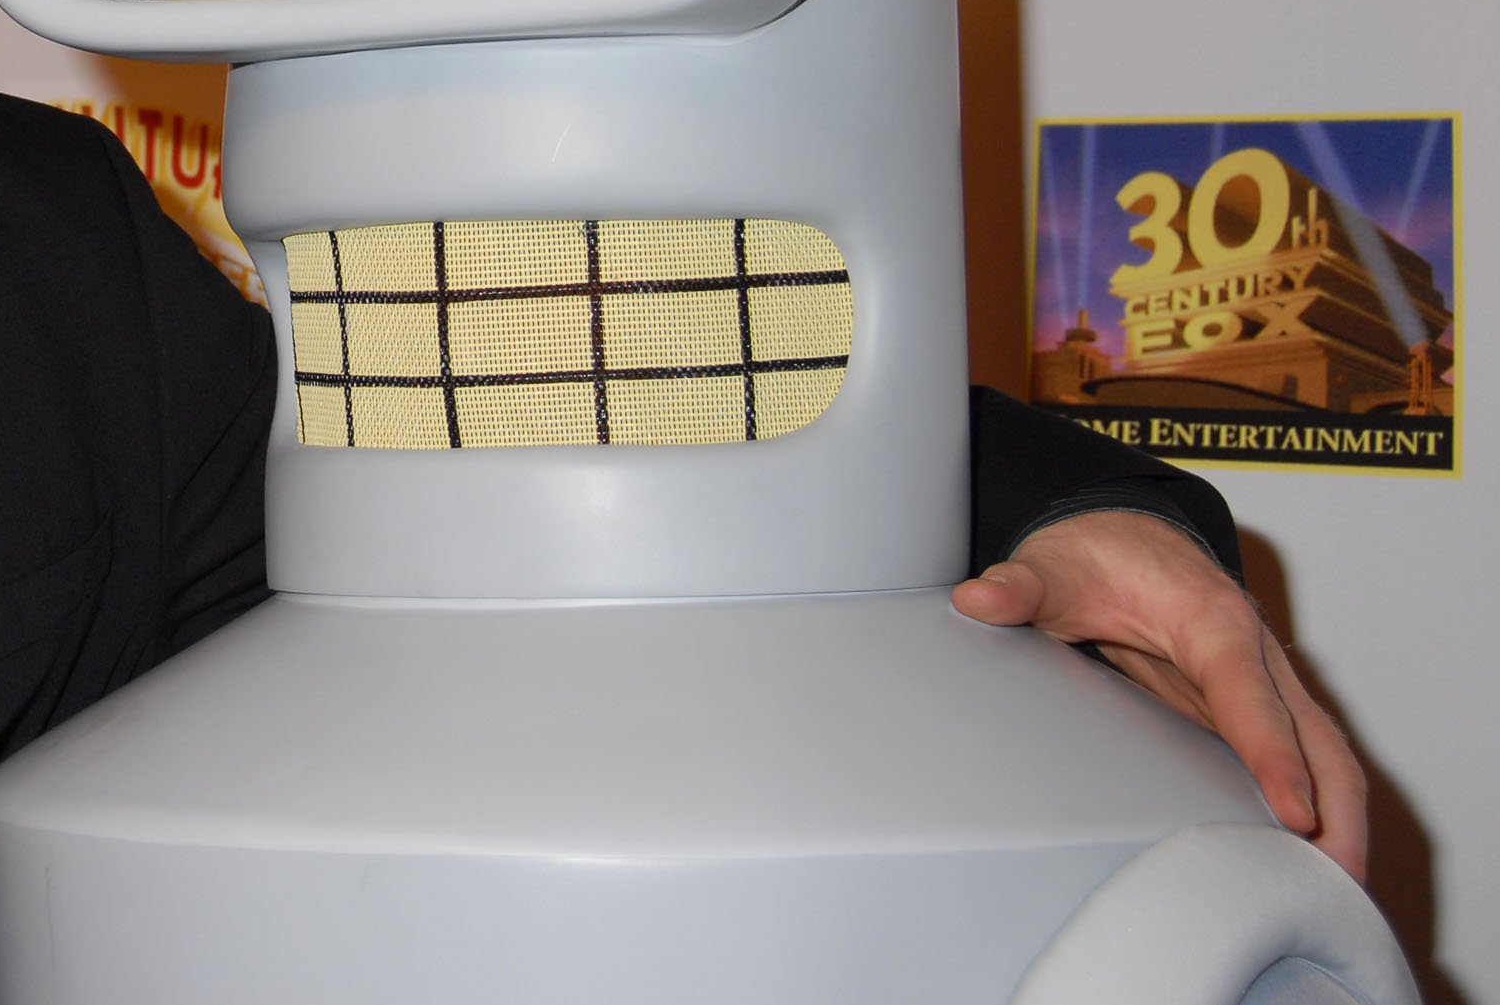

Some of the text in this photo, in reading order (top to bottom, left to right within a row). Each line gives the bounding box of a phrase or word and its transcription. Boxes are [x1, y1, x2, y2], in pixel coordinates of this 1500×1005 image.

[1109, 147, 1329, 287] 30th
[1124, 261, 1320, 324] CENTURY
[1126, 297, 1318, 359] FOX
[1149, 417, 1444, 457] ENTERTAINMENT
